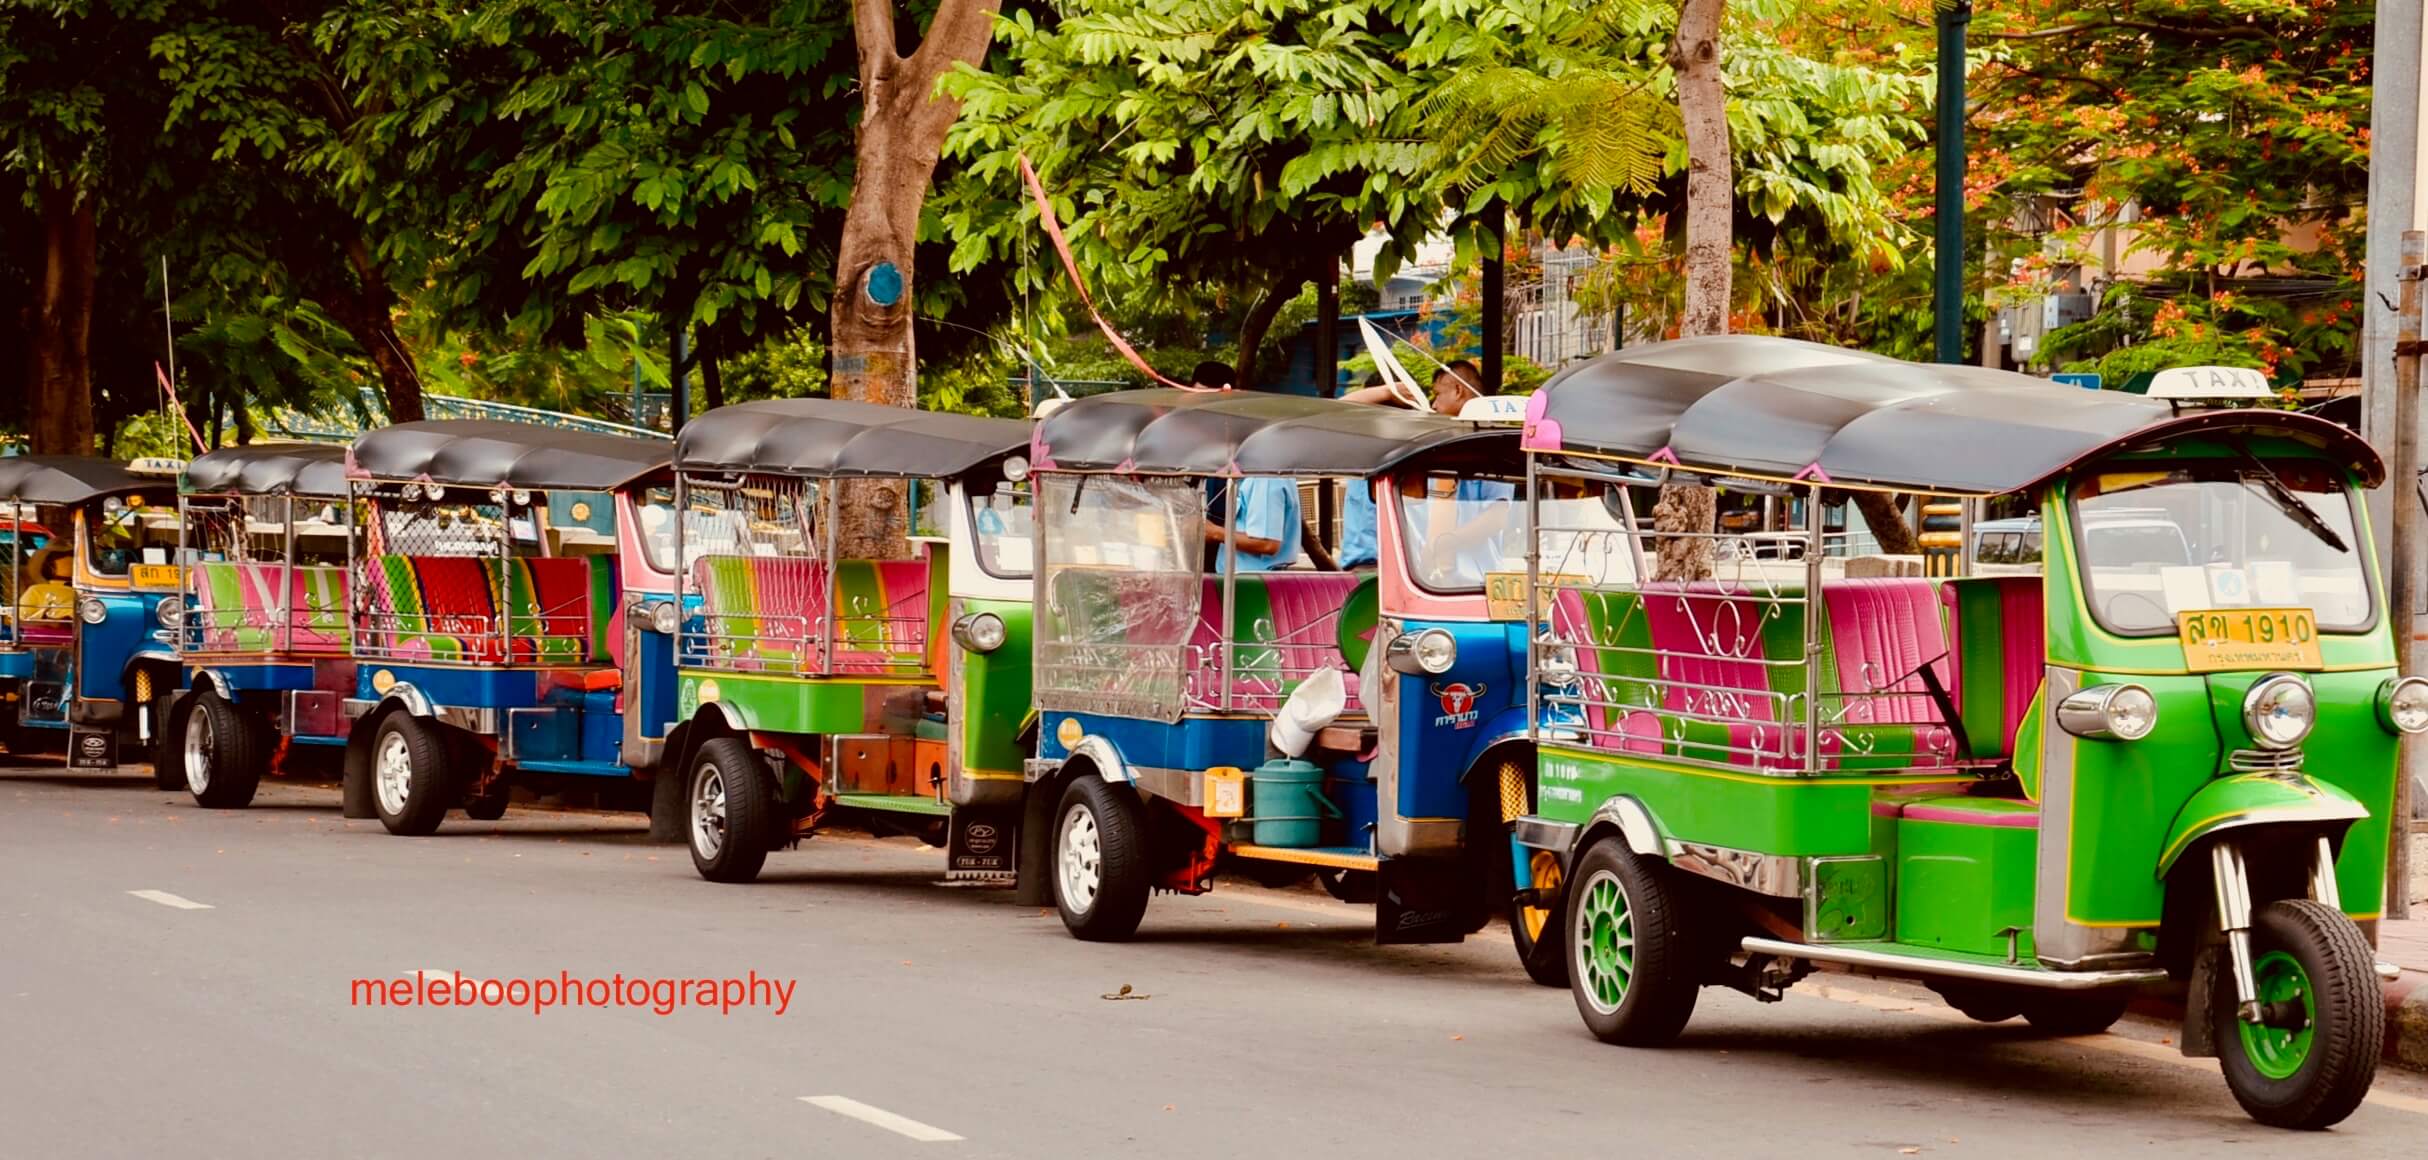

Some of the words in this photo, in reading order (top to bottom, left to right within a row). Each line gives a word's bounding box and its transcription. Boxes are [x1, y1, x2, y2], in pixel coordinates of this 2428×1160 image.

[2182, 370, 2261, 389] TAXI
[1488, 399, 1526, 413] TA
[2186, 614, 2229, 644] สข
[2242, 614, 2310, 643] 1910
